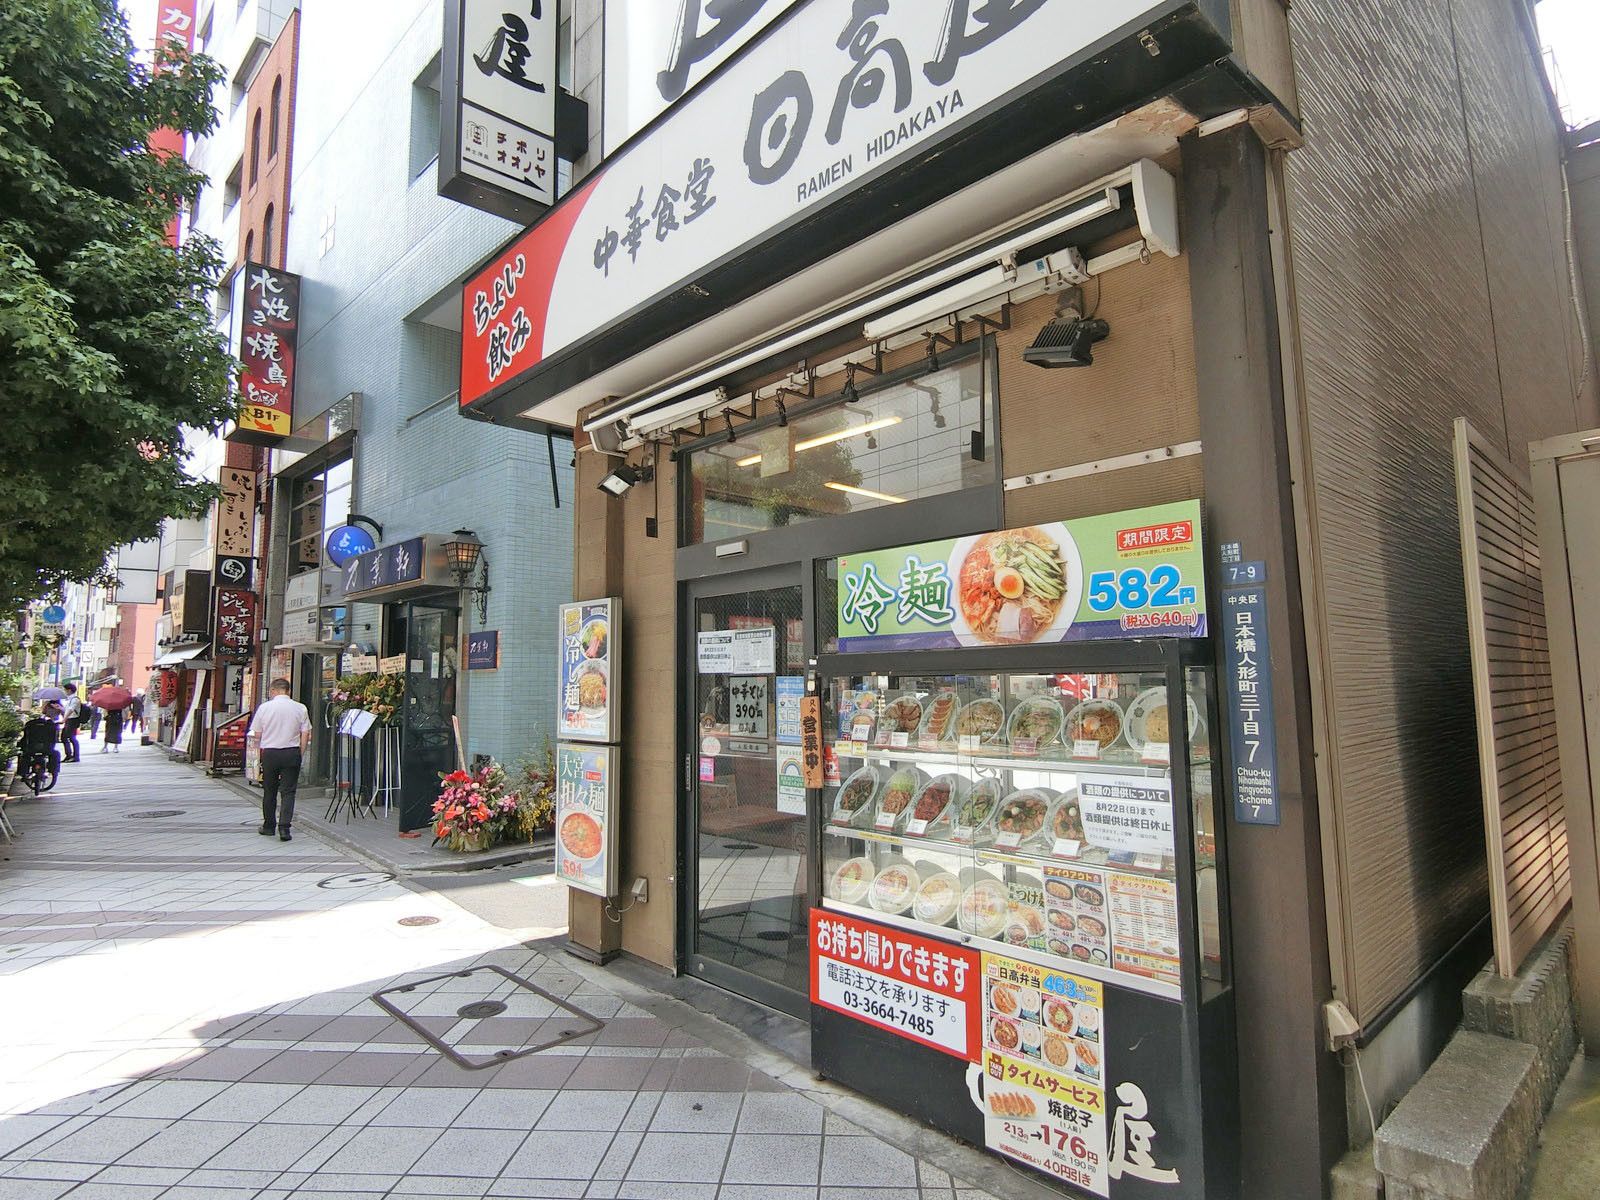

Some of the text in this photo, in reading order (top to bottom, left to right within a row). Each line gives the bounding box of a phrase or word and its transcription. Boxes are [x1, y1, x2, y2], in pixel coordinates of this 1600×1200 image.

[797, 89, 964, 202] RAMEN HIDAKAYA
[593, 157, 717, 278] 中華食堂
[486, 306, 532, 382] 飲み
[246, 331, 287, 388] 焼鳥
[253, 407, 280, 421] B1F
[1123, 525, 1187, 547] 期間限定
[1229, 566, 1256, 580] 7-9
[842, 555, 954, 635] 冷麺
[1088, 564, 1197, 613] 582円
[1228, 594, 1258, 605] 中央区
[1120, 608, 1199, 631] (税込640円)
[731, 680, 766, 701] 中華そば
[1234, 612, 1261, 763] 日本橋人形町三丁目 7
[1237, 766, 1271, 777] Chuo-ku
[1238, 776, 1272, 786] Nihonbashi
[1085, 784, 1166, 801] 酒類の提供について
[1238, 784, 1272, 796] ningyocho
[1239, 794, 1273, 805] 3-chome
[1096, 802, 1156, 816] 8月22日(日)まで
[1251, 805, 1260, 818] 7
[1084, 812, 1172, 832] 酒類提供は終日休止
[1047, 867, 1094, 881] テイクアウト
[817, 919, 970, 993] お持ち帰りできます
[1000, 966, 1041, 989] 日高弁当
[826, 962, 957, 1023] 電話注文を承ります。
[843, 990, 934, 1036] 03-3664-7485
[1007, 1063, 1101, 1109] タイムサービス
[1048, 1098, 1094, 1128] 焼餃子
[1040, 1124, 1098, 1165] 176円
[1043, 1159, 1092, 1187] 40円引き
